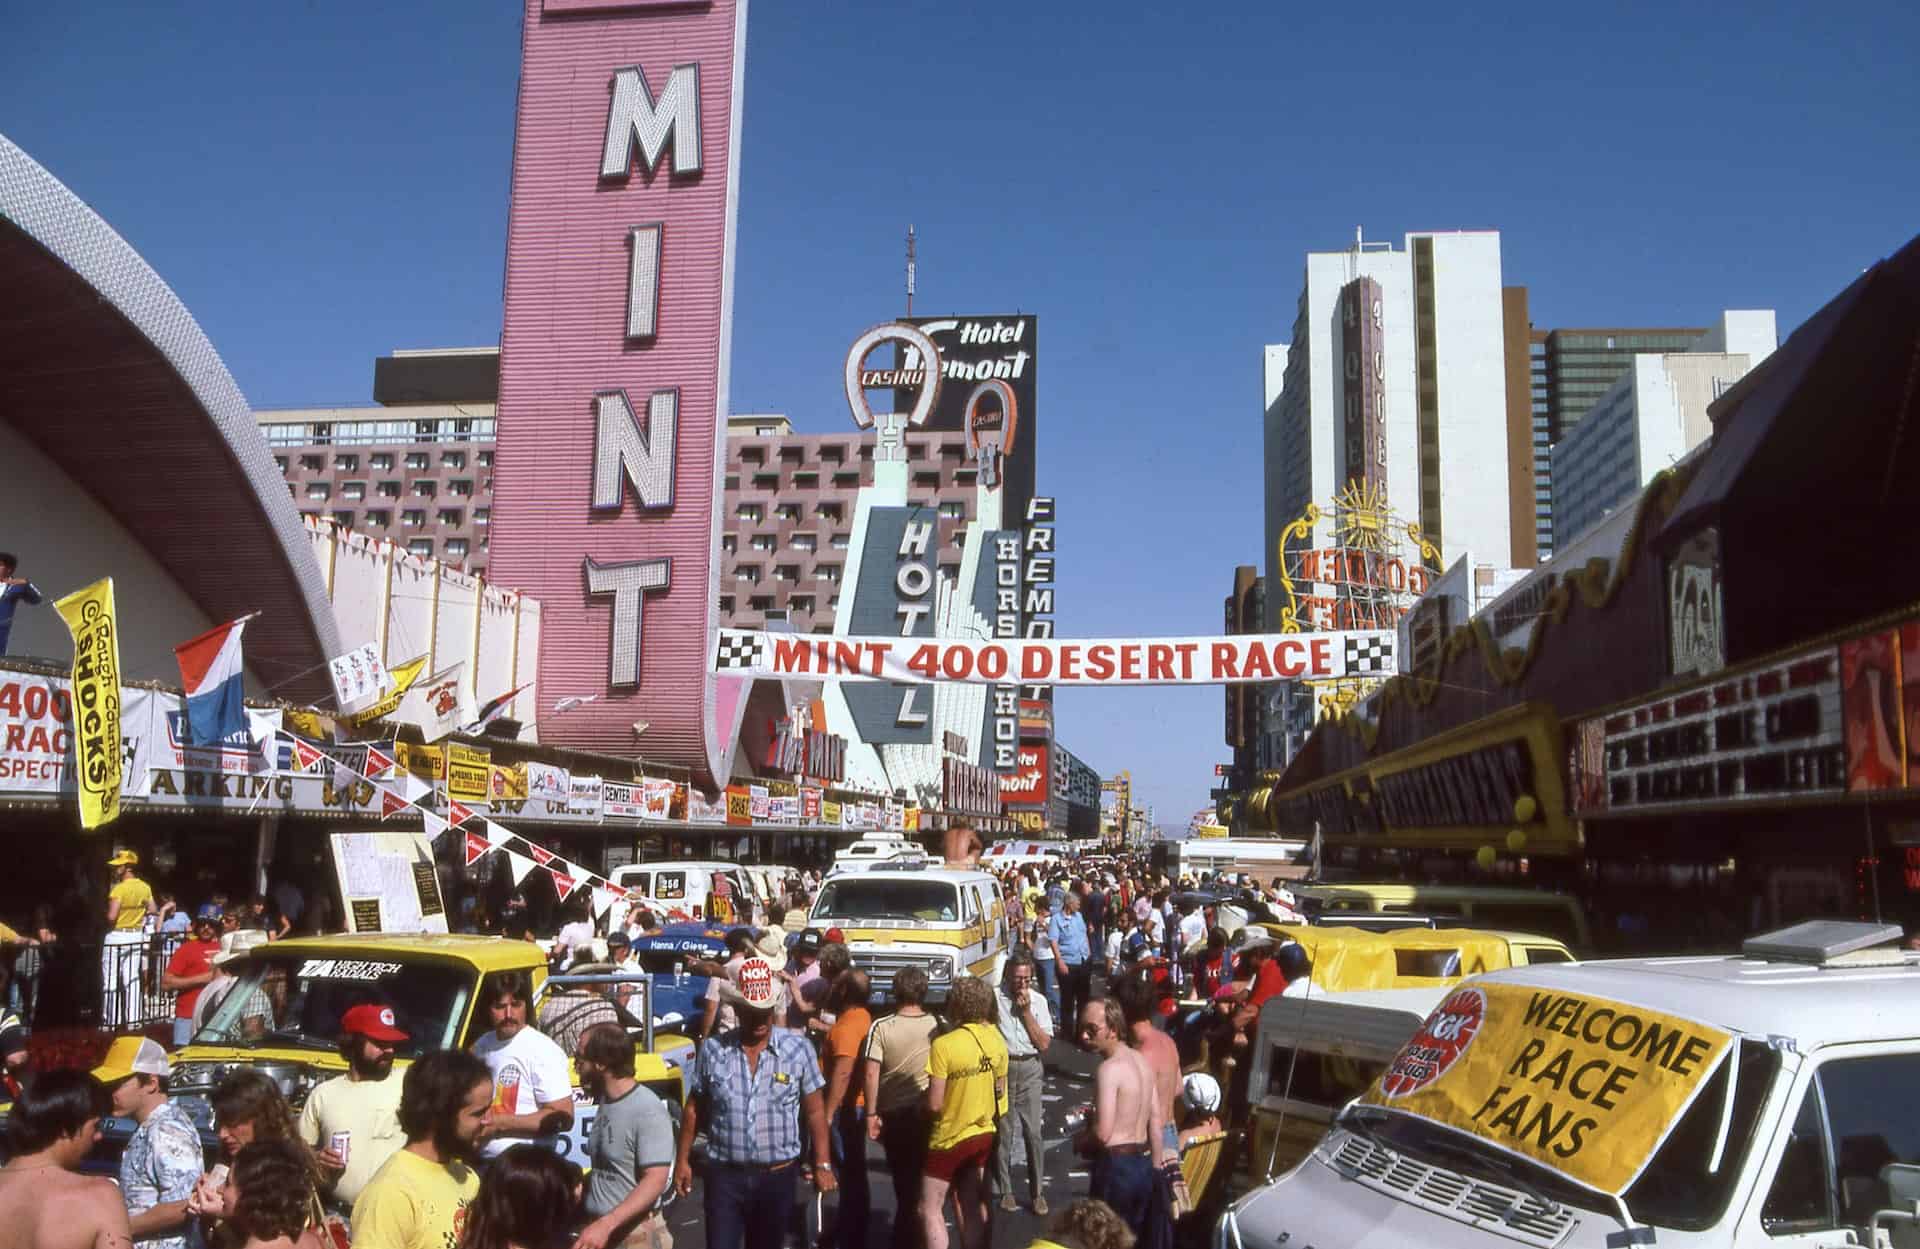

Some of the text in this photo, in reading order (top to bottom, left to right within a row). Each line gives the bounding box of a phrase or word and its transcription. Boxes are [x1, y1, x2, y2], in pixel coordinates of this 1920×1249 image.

[903, 320, 1030, 381] Femont
[959, 320, 1025, 344] Hotel
[584, 61, 702, 688] MINT
[896, 521, 933, 723] HOTL
[1025, 497, 1054, 701] FREMOT
[94, 621, 114, 689] Rough
[773, 638, 1332, 680] MINT 400 DESERT RACE
[994, 537, 1019, 768] HORSHOE
[6, 724, 73, 755] RAC
[77, 634, 107, 785] SHOCKS
[151, 768, 293, 801] ARKING
[605, 786, 630, 803] CENTER
[651, 940, 674, 950] Hanna
[1522, 991, 1711, 1077] WELCOME
[1509, 1038, 1637, 1111] RACE
[1472, 1086, 1597, 1159] FANS
